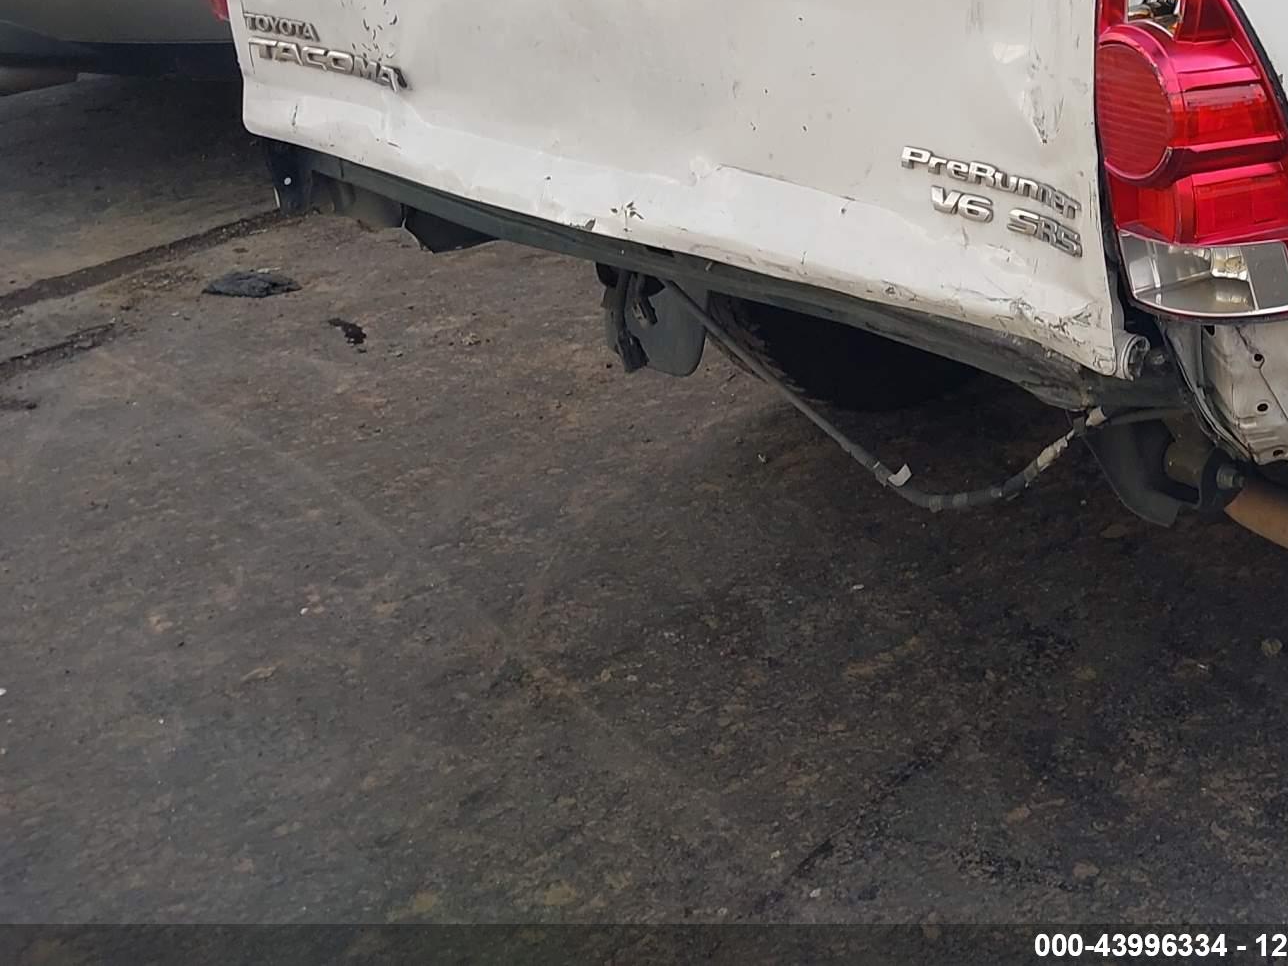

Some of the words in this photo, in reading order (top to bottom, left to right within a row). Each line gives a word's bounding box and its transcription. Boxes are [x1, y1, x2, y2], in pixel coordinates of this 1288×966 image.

[244, 11, 320, 42] TOYOTA
[248, 35, 407, 92] TACOMA
[901, 145, 1082, 220] PreRunner
[930, 184, 994, 224] V6
